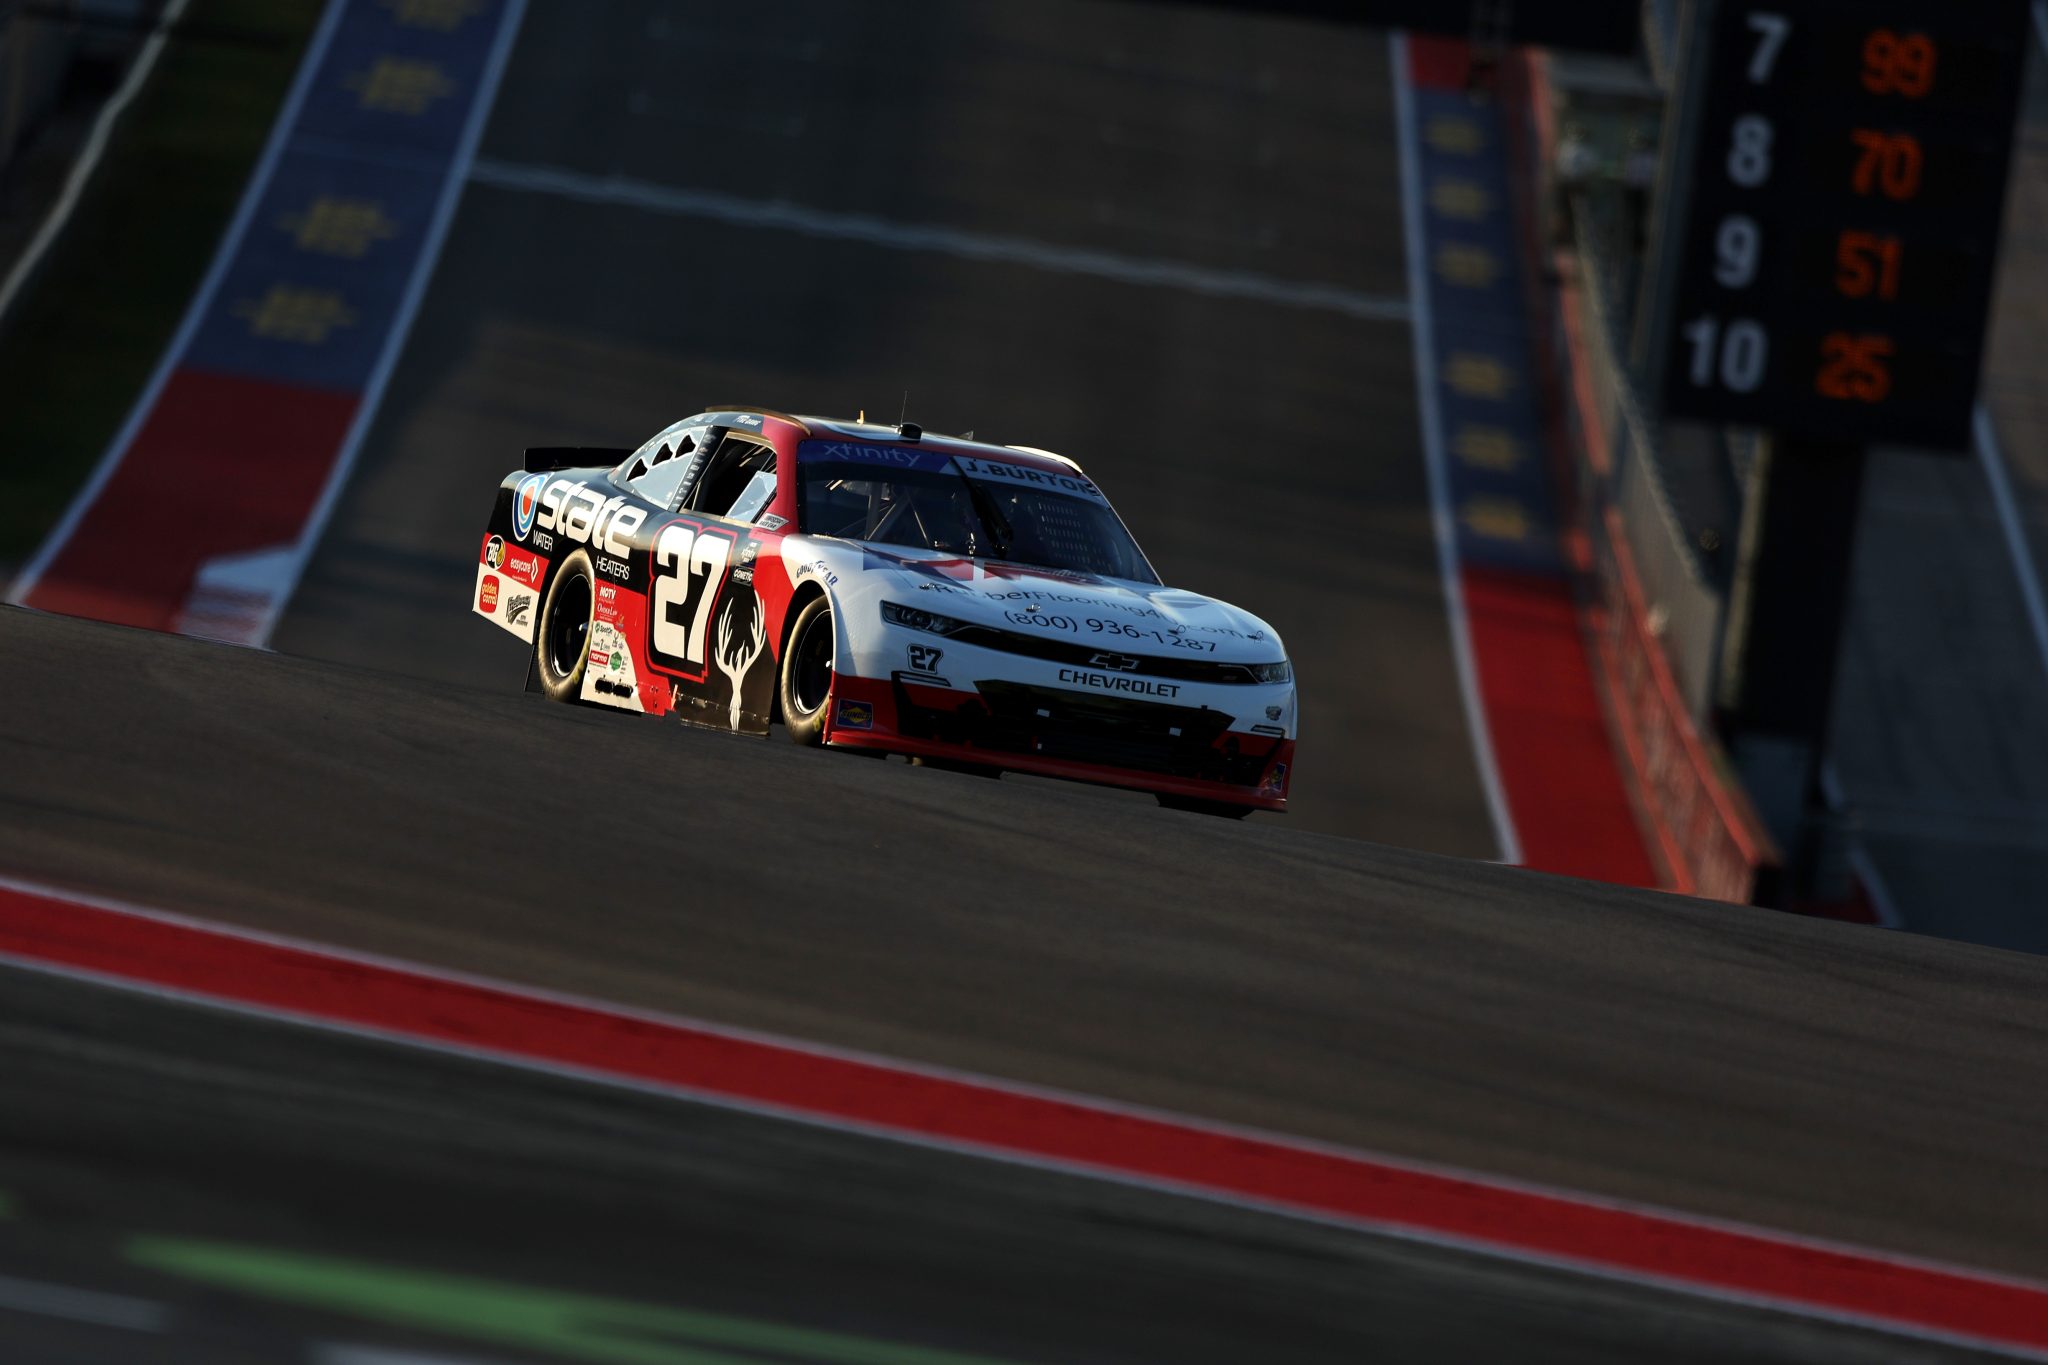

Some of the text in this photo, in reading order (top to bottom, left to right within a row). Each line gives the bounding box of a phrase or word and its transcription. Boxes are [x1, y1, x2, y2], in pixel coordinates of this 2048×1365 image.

[1746, 12, 1790, 84] 7
[1861, 28, 1939, 98] 99
[1727, 114, 1773, 188] 8
[1851, 127, 1923, 200] 70
[1715, 214, 1761, 289] 9
[1835, 229, 1903, 298] 51
[1684, 315, 1768, 393] 10
[1815, 330, 1896, 401] 25
[823, 442, 921, 467] xfinity
[533, 529, 554, 553] WATER
[537, 479, 648, 559] state
[596, 555, 631, 580] HEATERS
[653, 525, 731, 665] 27
[909, 645, 942, 672] 27
[1004, 610, 1218, 652] (800) 936-1287
[1058, 668, 1181, 698] CHEVROLET
